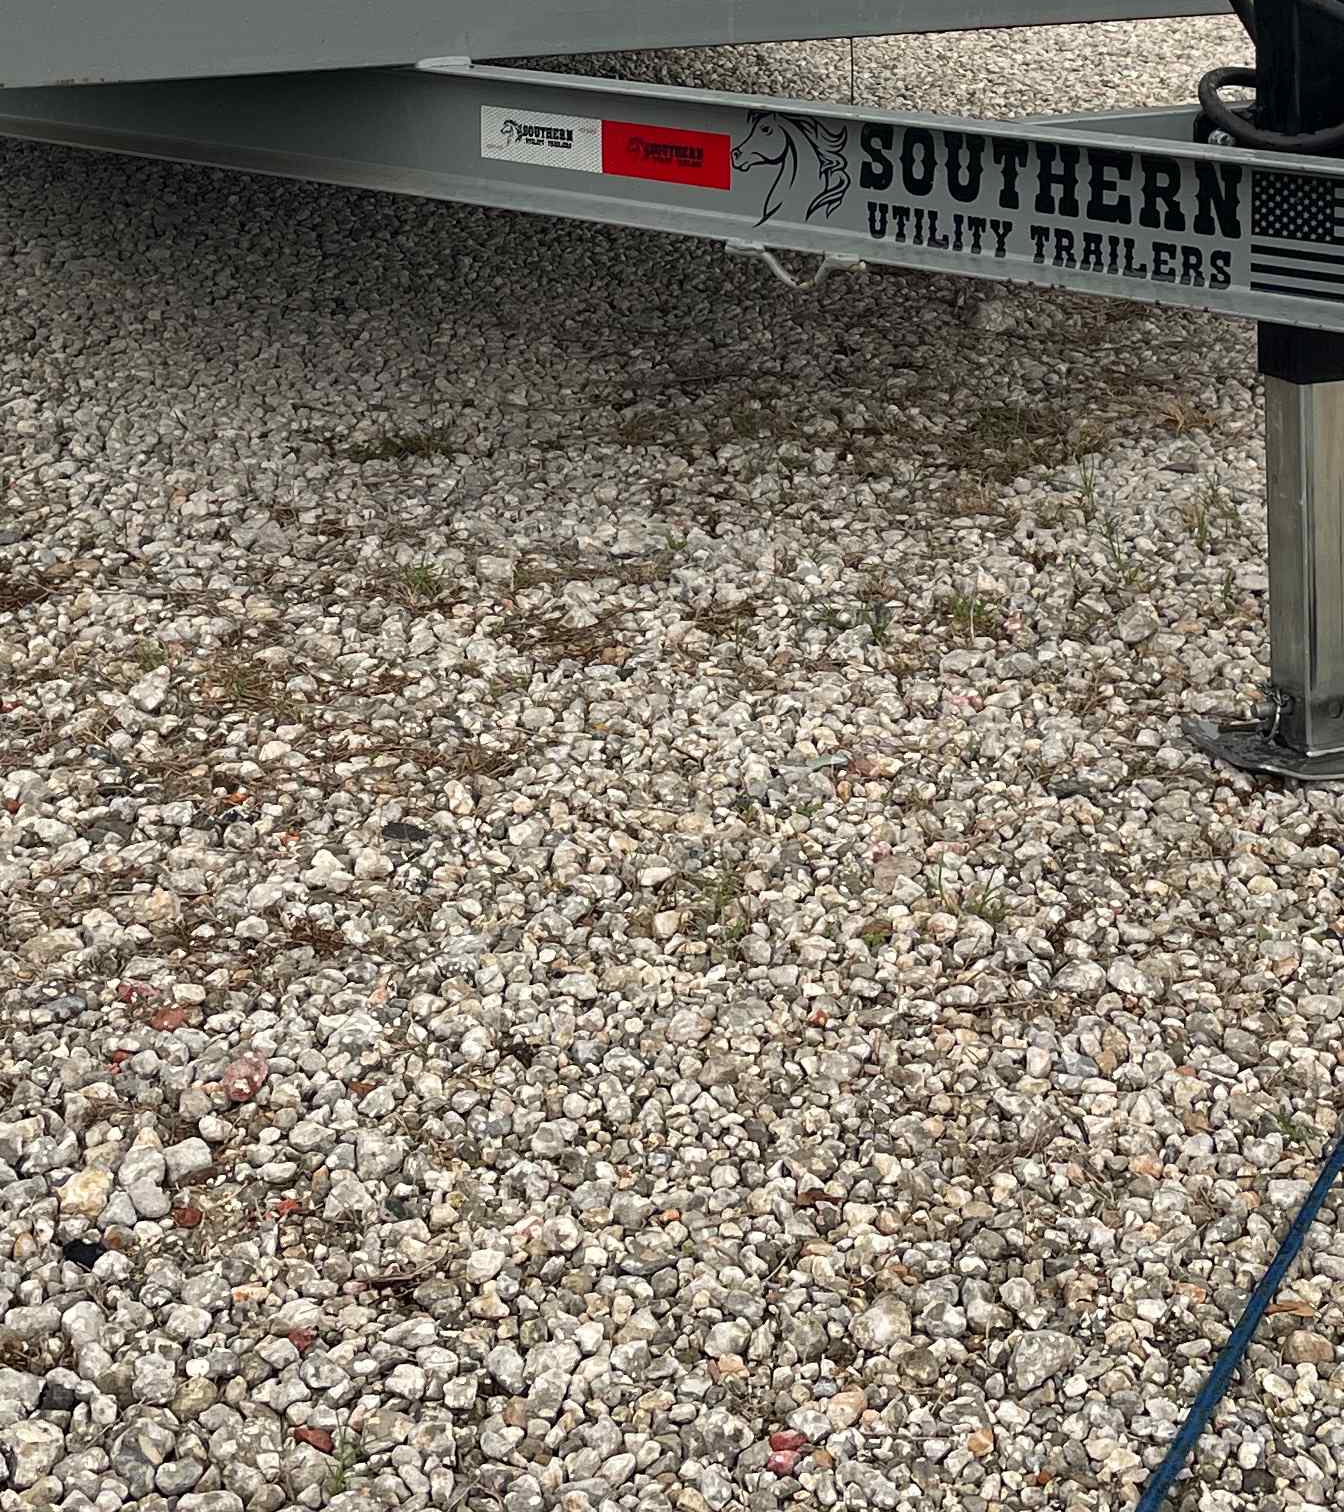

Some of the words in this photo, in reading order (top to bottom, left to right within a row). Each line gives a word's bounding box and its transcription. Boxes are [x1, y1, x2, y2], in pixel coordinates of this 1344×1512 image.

[522, 125, 574, 142] SOUTHERN
[859, 122, 1242, 239] SOUTHERN
[867, 201, 1013, 258] UTILITY
[1030, 224, 1232, 290] TRAILERS
